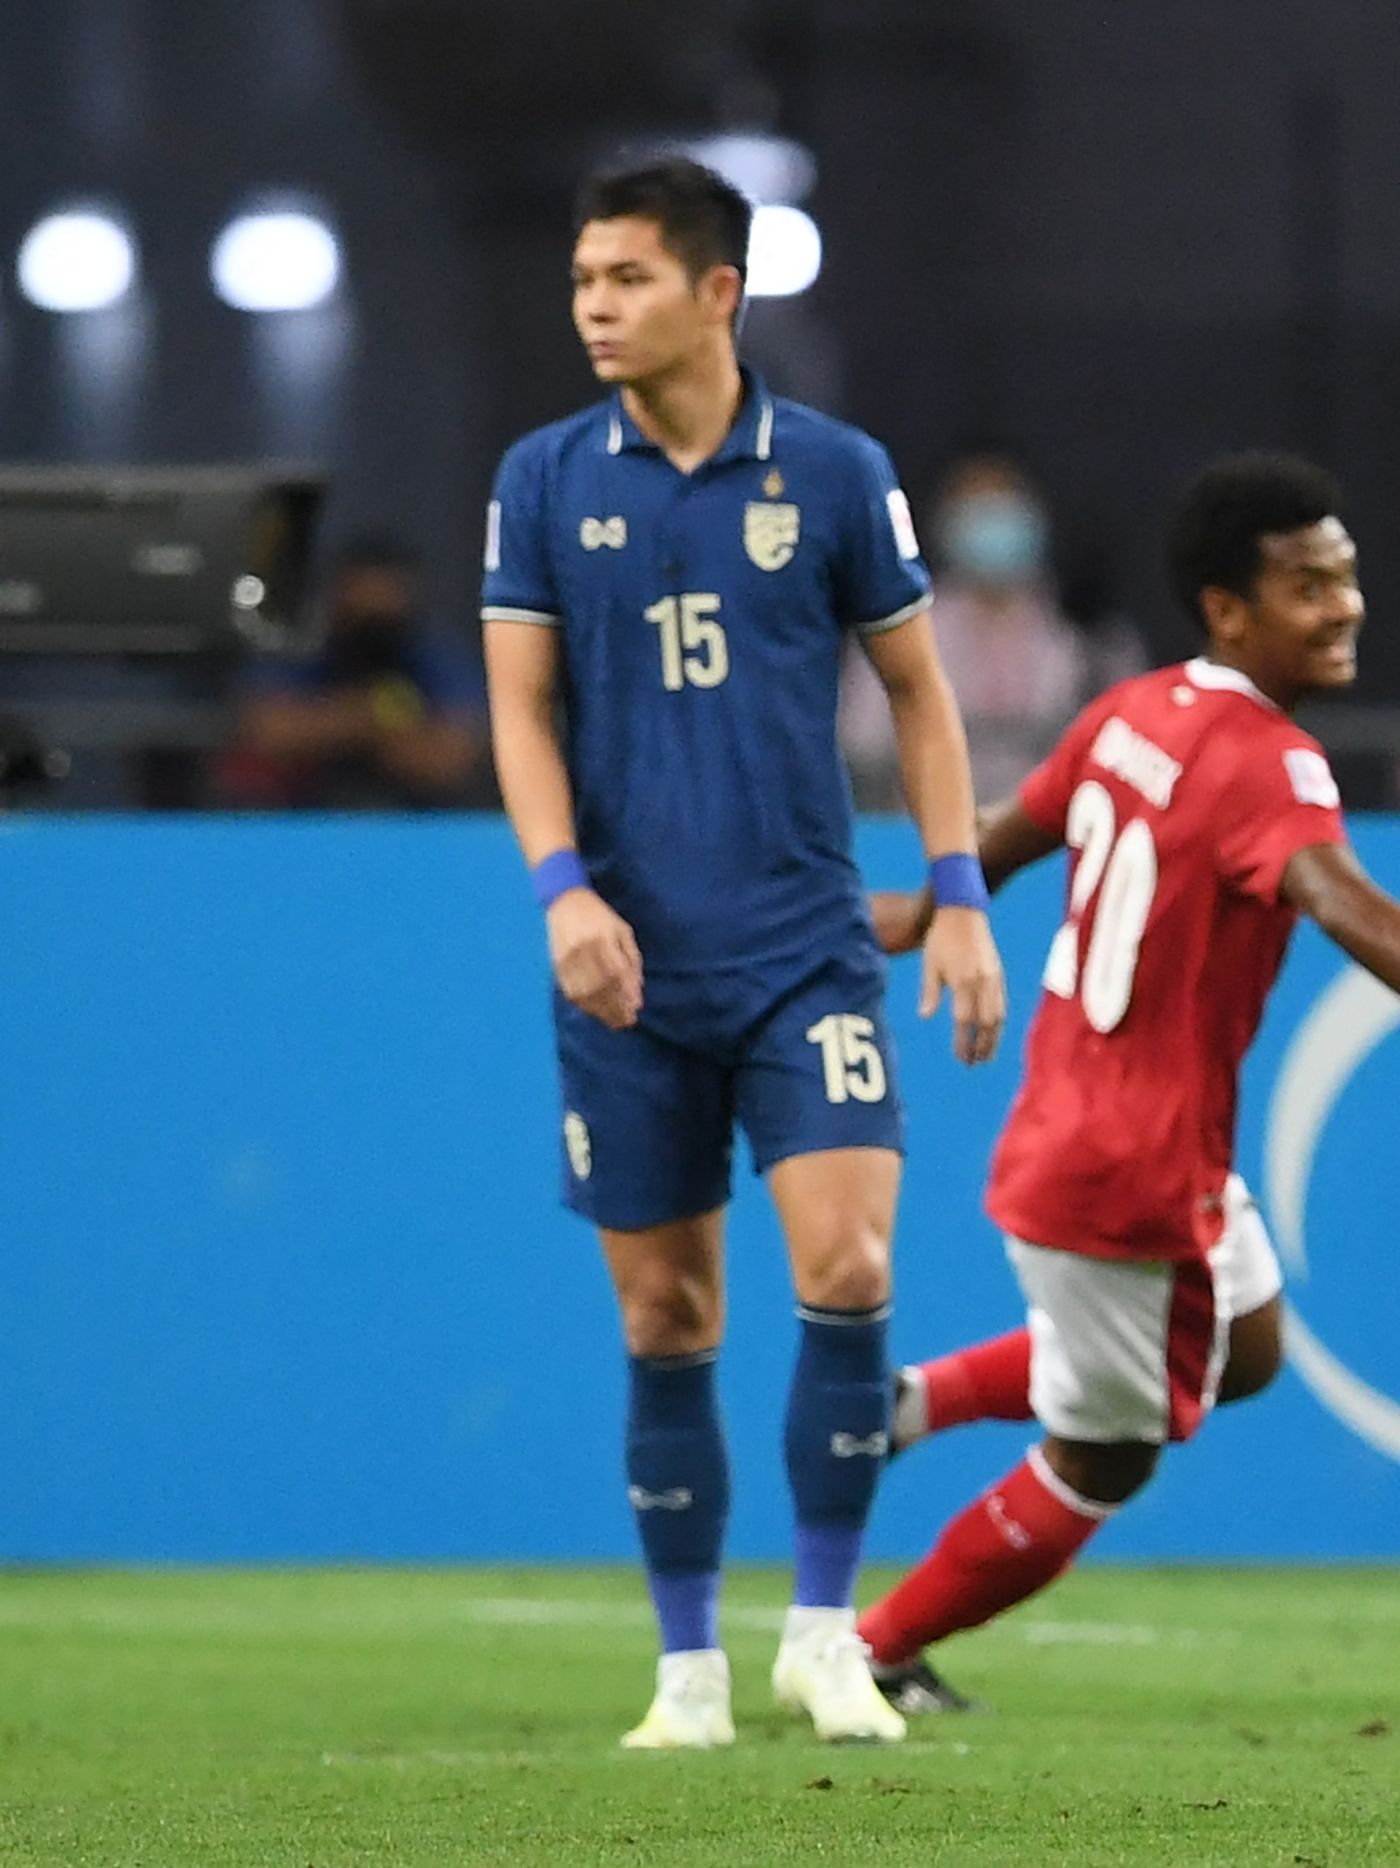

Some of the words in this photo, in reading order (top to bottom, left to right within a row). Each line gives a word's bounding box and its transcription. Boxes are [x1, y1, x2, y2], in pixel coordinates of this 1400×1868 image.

[643, 591, 731, 693] 15
[1042, 778, 1160, 1036] 20
[805, 1012, 888, 1105] 15
